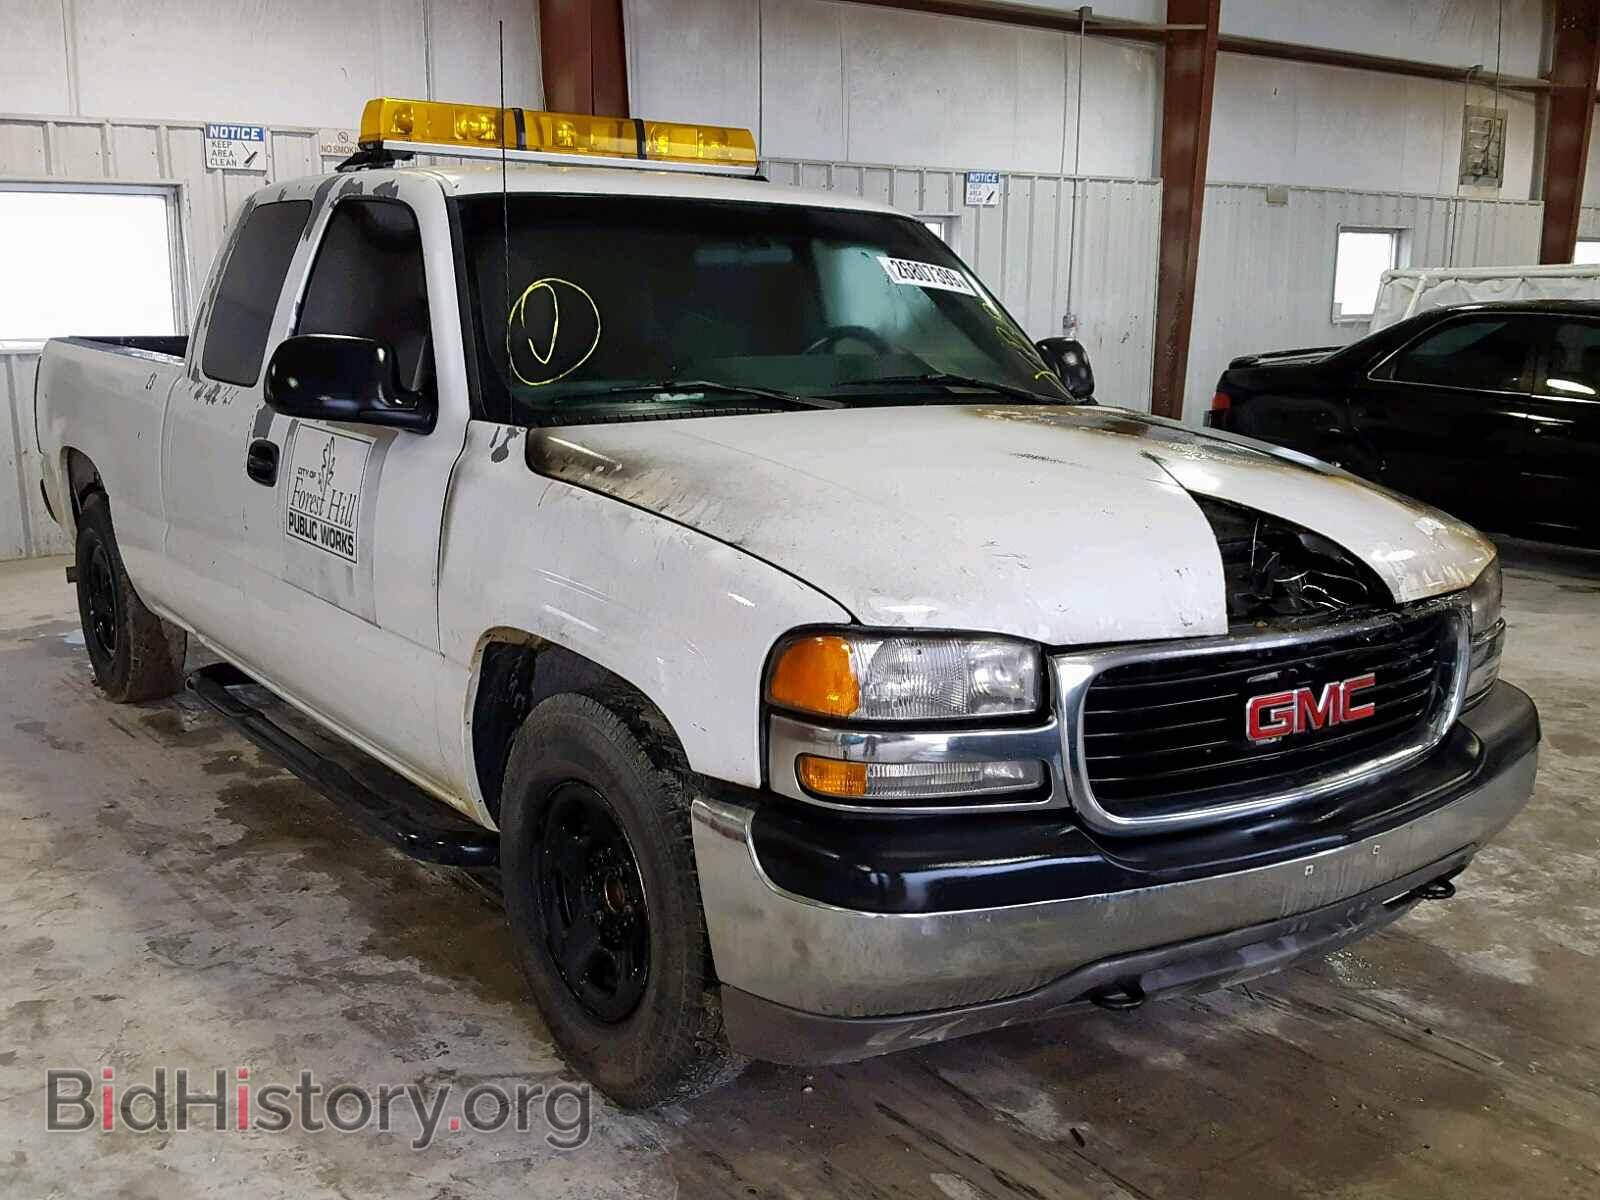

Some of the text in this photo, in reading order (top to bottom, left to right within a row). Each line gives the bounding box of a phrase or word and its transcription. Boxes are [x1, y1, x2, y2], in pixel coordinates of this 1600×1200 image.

[209, 126, 261, 140] NOTICE
[212, 141, 232, 149] KEEP
[212, 149, 234, 157] AREA
[210, 158, 237, 167] CLEAN
[970, 173, 998, 183] NOTICE
[297, 467, 317, 479] CITY OF
[290, 476, 357, 528] Forest Hill
[288, 511, 354, 557] PUBLIC WORKS
[1246, 672, 1376, 741] GMC
